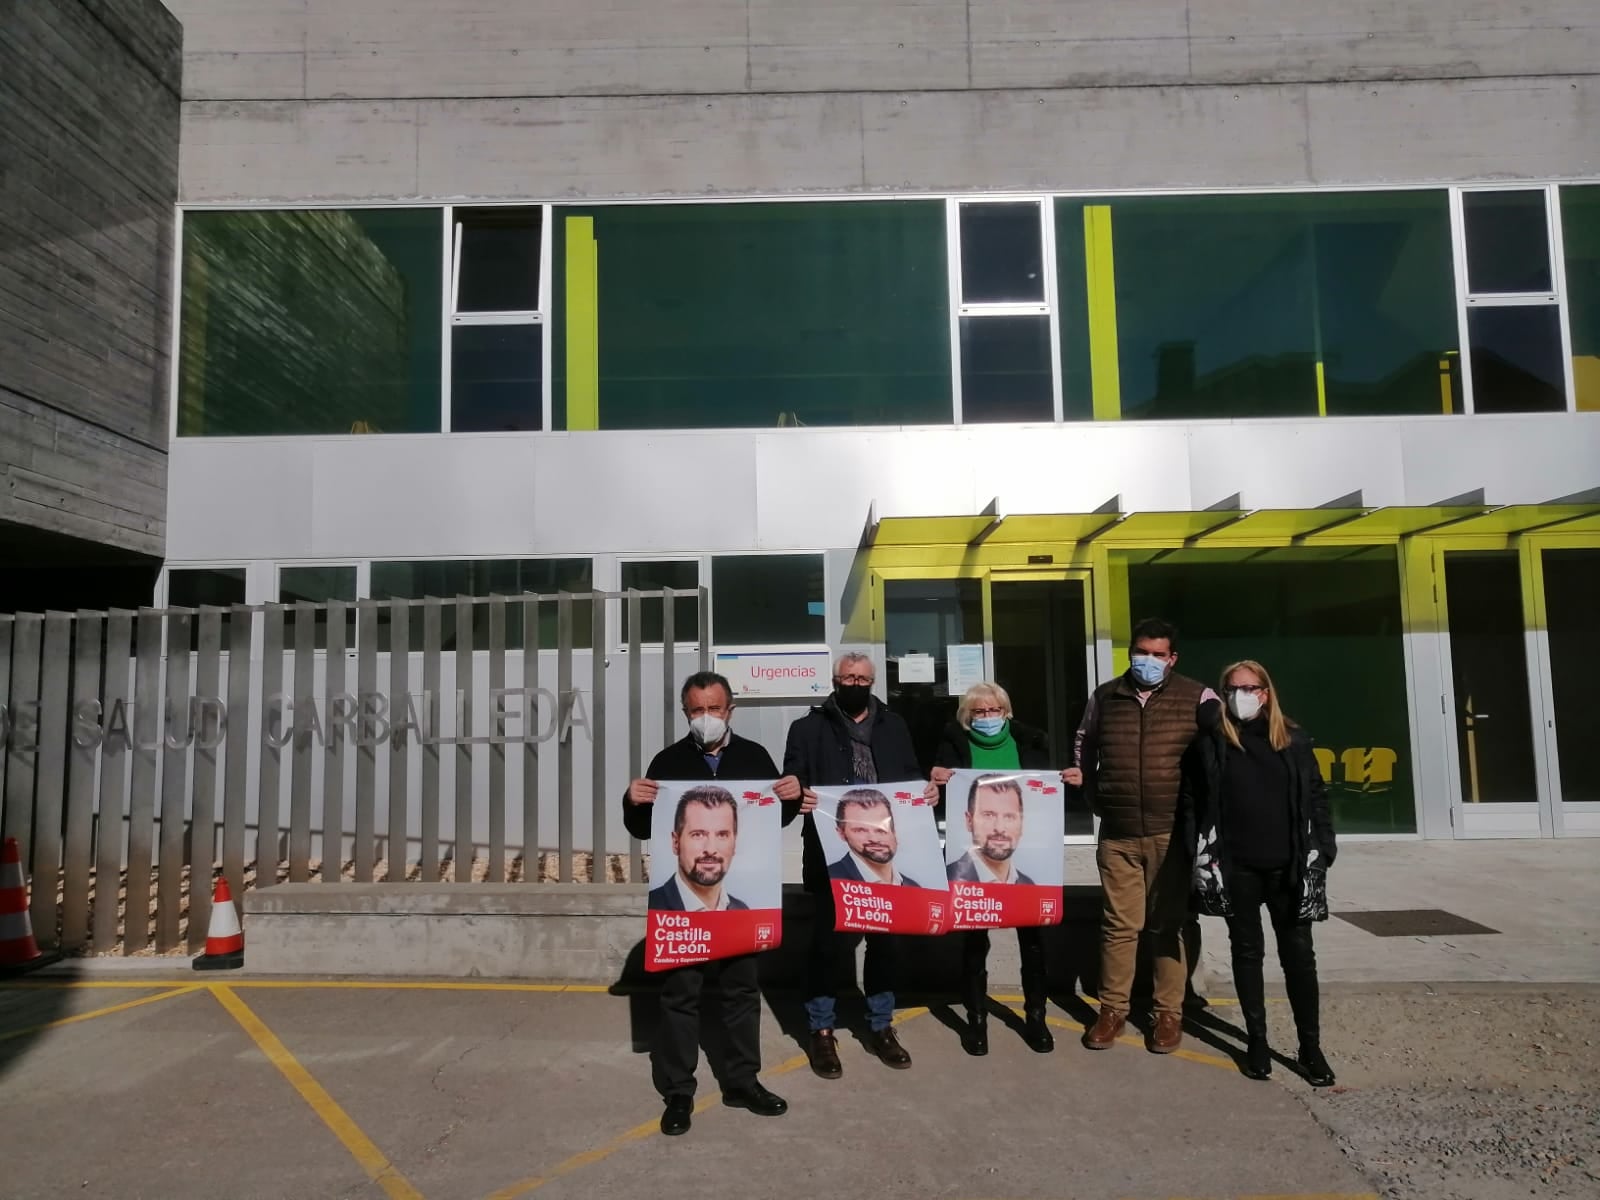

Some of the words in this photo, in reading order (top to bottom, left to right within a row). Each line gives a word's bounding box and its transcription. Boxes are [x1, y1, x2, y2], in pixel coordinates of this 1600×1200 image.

[751, 665, 816, 680] Urgencias
[0, 700, 41, 752] E
[73, 694, 228, 751] SALUD
[265, 687, 594, 749] CARBALLEDA
[840, 882, 872, 895] Vota
[954, 884, 984, 896] Vota
[843, 894, 893, 910] Castilla
[953, 898, 1003, 911] Castilla
[656, 913, 690, 927] Vota
[845, 907, 853, 920] y
[857, 907, 893, 923] León.
[954, 911, 962, 923] y
[966, 909, 1003, 922] León.
[655, 928, 711, 942] Castilla
[655, 944, 664, 957] y
[669, 941, 711, 954] León.
